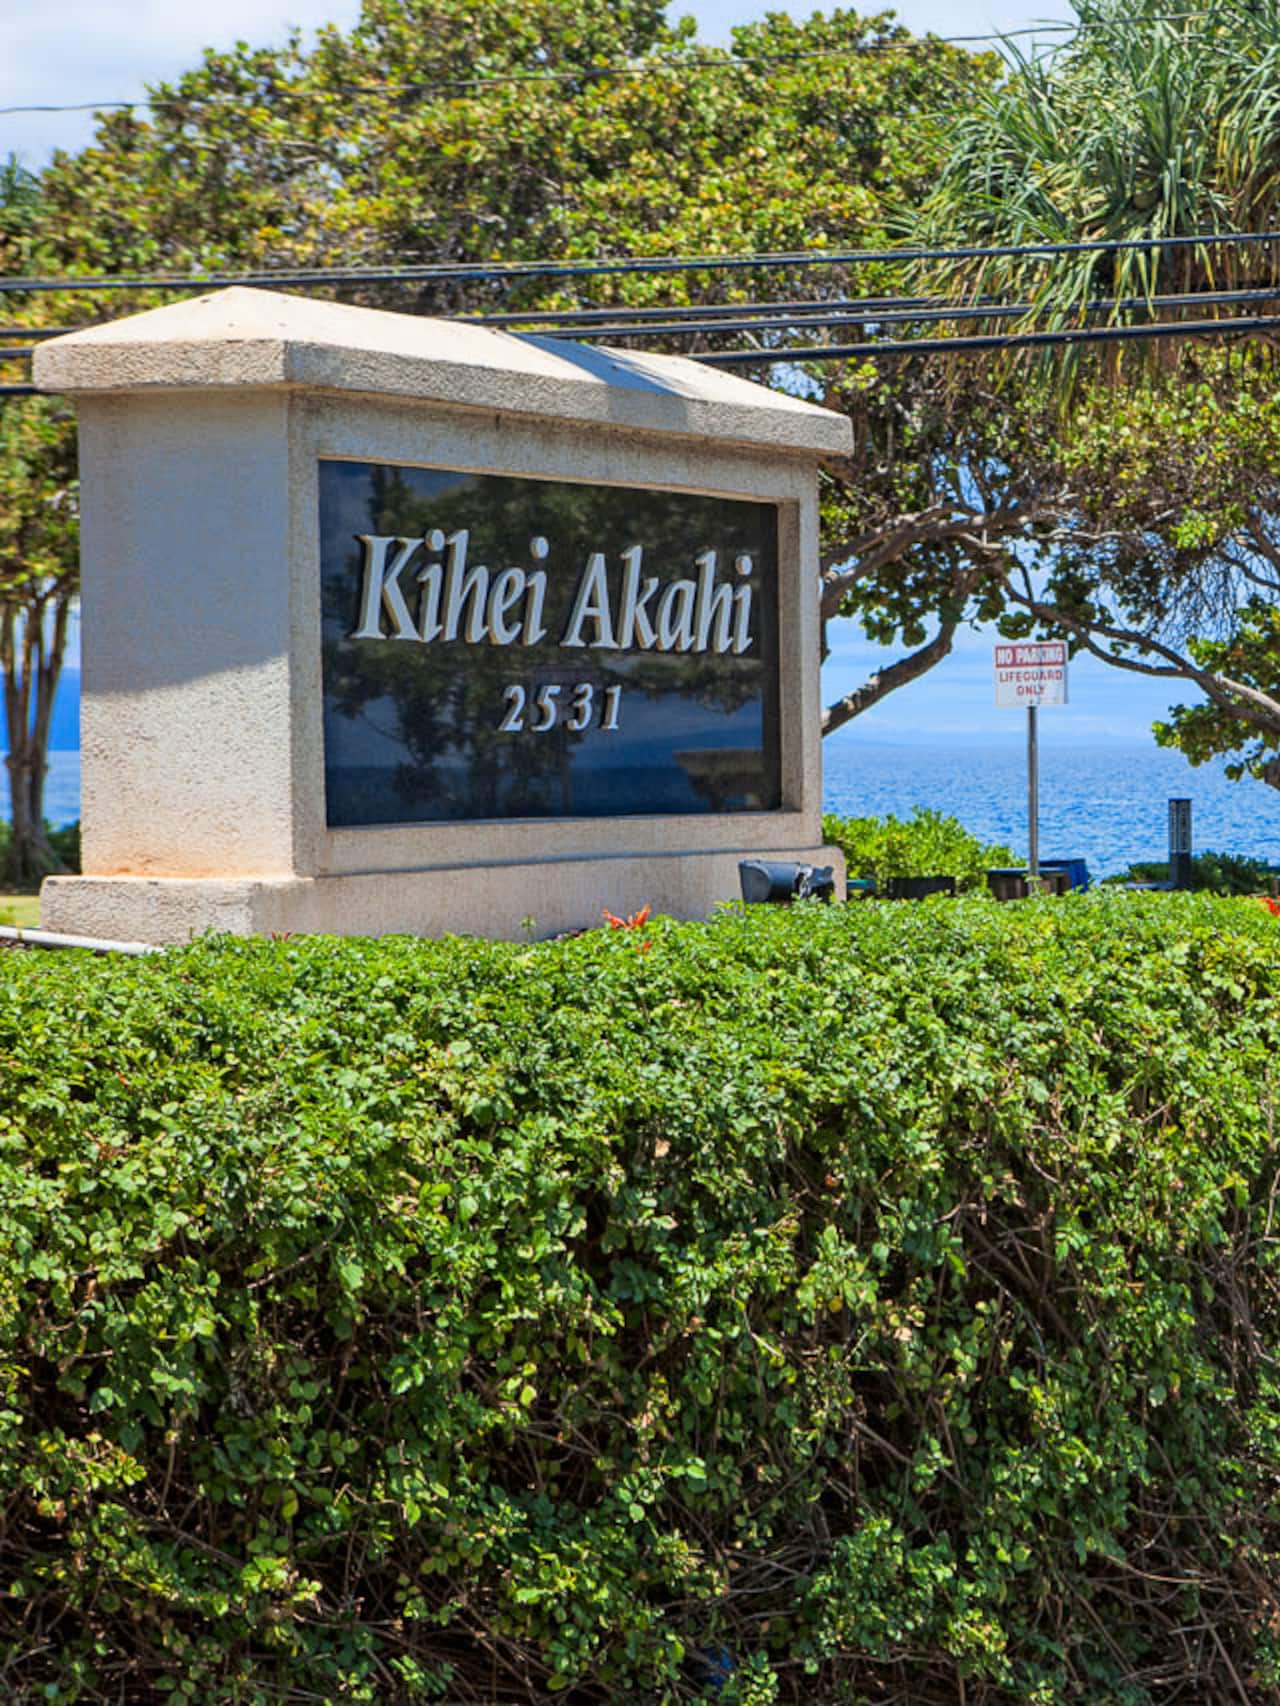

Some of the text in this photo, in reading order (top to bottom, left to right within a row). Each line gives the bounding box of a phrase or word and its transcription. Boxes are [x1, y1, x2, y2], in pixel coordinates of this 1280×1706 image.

[350, 528, 754, 655] Kihei Akahi
[996, 648, 1013, 665] NO
[999, 670, 1063, 682] LIFEGUARD
[1016, 686, 1045, 696] ONLY
[500, 683, 623, 732] 2531
